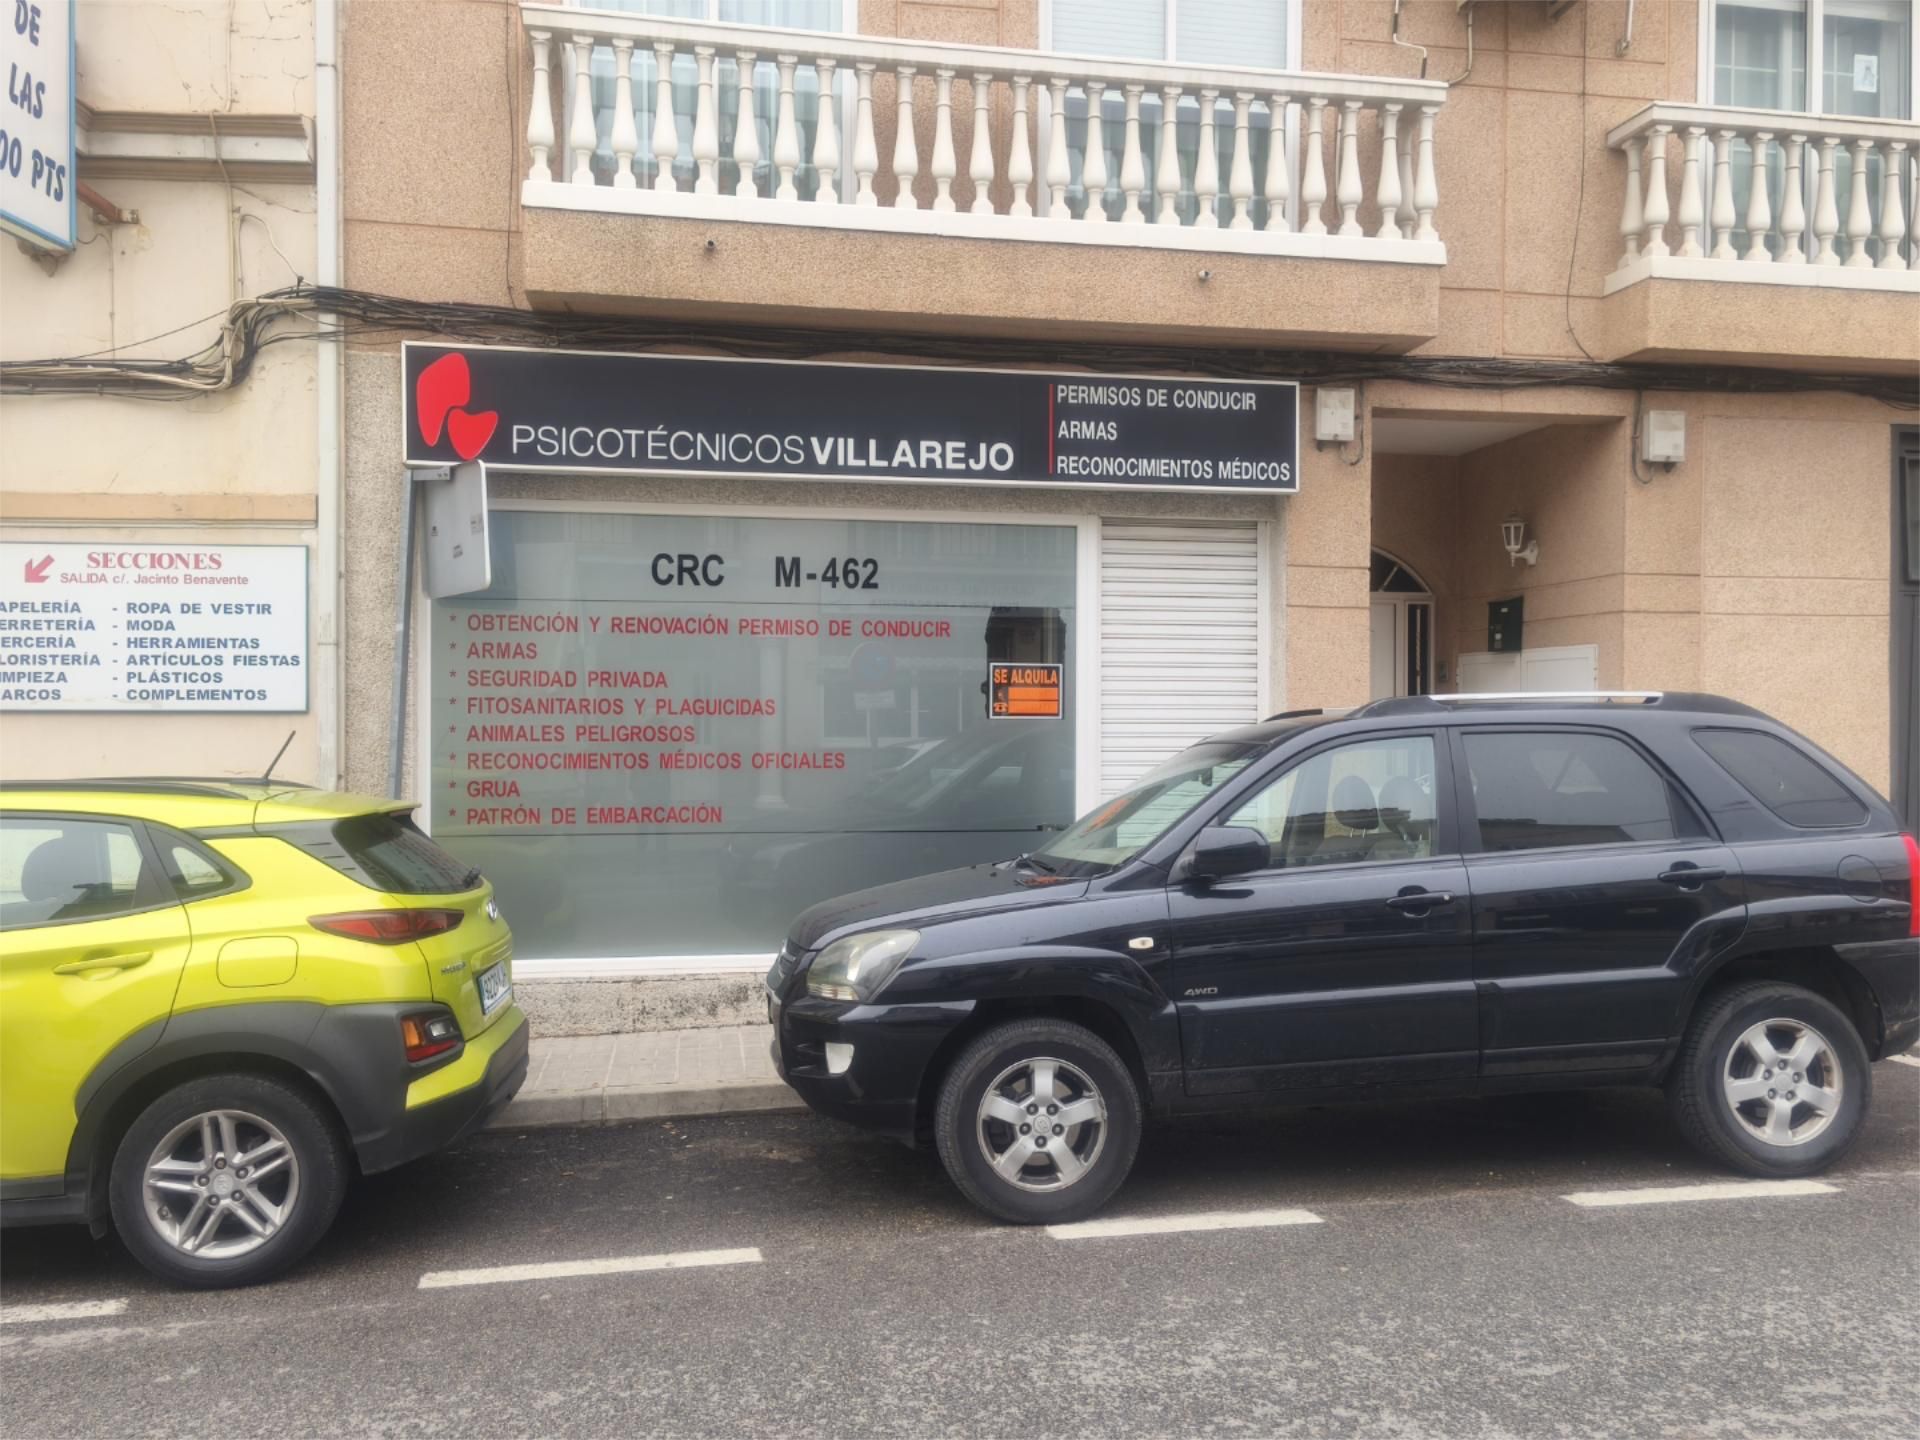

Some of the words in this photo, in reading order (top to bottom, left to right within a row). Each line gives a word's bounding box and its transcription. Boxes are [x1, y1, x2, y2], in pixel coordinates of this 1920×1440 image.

[14, 0, 41, 46] DE
[9, 62, 46, 119] LAS
[31, 149, 66, 202] PTS
[1057, 385, 1141, 407] PERMISOS
[1146, 390, 1168, 407] DE
[1173, 390, 1257, 411] CONDUCIR
[1058, 421, 1118, 441] ARMAS
[512, 425, 805, 465] PSICOTÉCNICOS
[810, 437, 1015, 473] VILLAREJO
[1056, 456, 1213, 479] RECONOCIMIENTOS
[1218, 457, 1291, 481] MÉDICOS
[87, 552, 223, 570] SECCIONES
[60, 572, 108, 585] SALIDA
[134, 573, 179, 585] Jacinto
[184, 574, 249, 586] Benavente
[651, 554, 725, 587] CRC
[775, 557, 880, 590] M-462
[126, 602, 171, 615] ROPA
[180, 602, 202, 615] DE
[211, 603, 272, 616] VESTIR
[126, 619, 176, 632] MODA
[467, 612, 578, 633] OBTENCIÓN
[589, 616, 601, 633] Y
[610, 613, 729, 635] RENOVACIÓN
[738, 618, 819, 637] PERMISO
[828, 619, 853, 637] DE
[861, 619, 951, 639] CONDUCIR
[126, 637, 260, 650] HERRAMIENTAS
[467, 642, 538, 660] ARMAS
[126, 652, 224, 667] ARTÍCULOS
[233, 655, 301, 667] FIESTAS
[126, 669, 223, 684] PLÁSTICOS
[467, 670, 577, 688] SEGURIDAD
[587, 671, 668, 689] PRIVADA
[994, 669, 1008, 684] SE
[1011, 669, 1058, 684] ALQUILA
[126, 689, 268, 702] COMPLEMENTOS
[467, 697, 625, 716] FITOSANITARIOS
[634, 699, 646, 716] Y
[655, 699, 776, 717] PLAGUICIDAS
[466, 725, 566, 743] ANIMALES
[575, 725, 696, 743] PELIGROSOS
[467, 752, 650, 770] RECONOCIMIENTOS
[659, 748, 742, 770] MÉDICOS
[752, 752, 846, 770] OFICIALES
[466, 780, 521, 799] GRUA
[466, 804, 541, 825] PATRÓN
[551, 807, 577, 825] DE
[586, 804, 723, 825] EMBARCACIÓN
